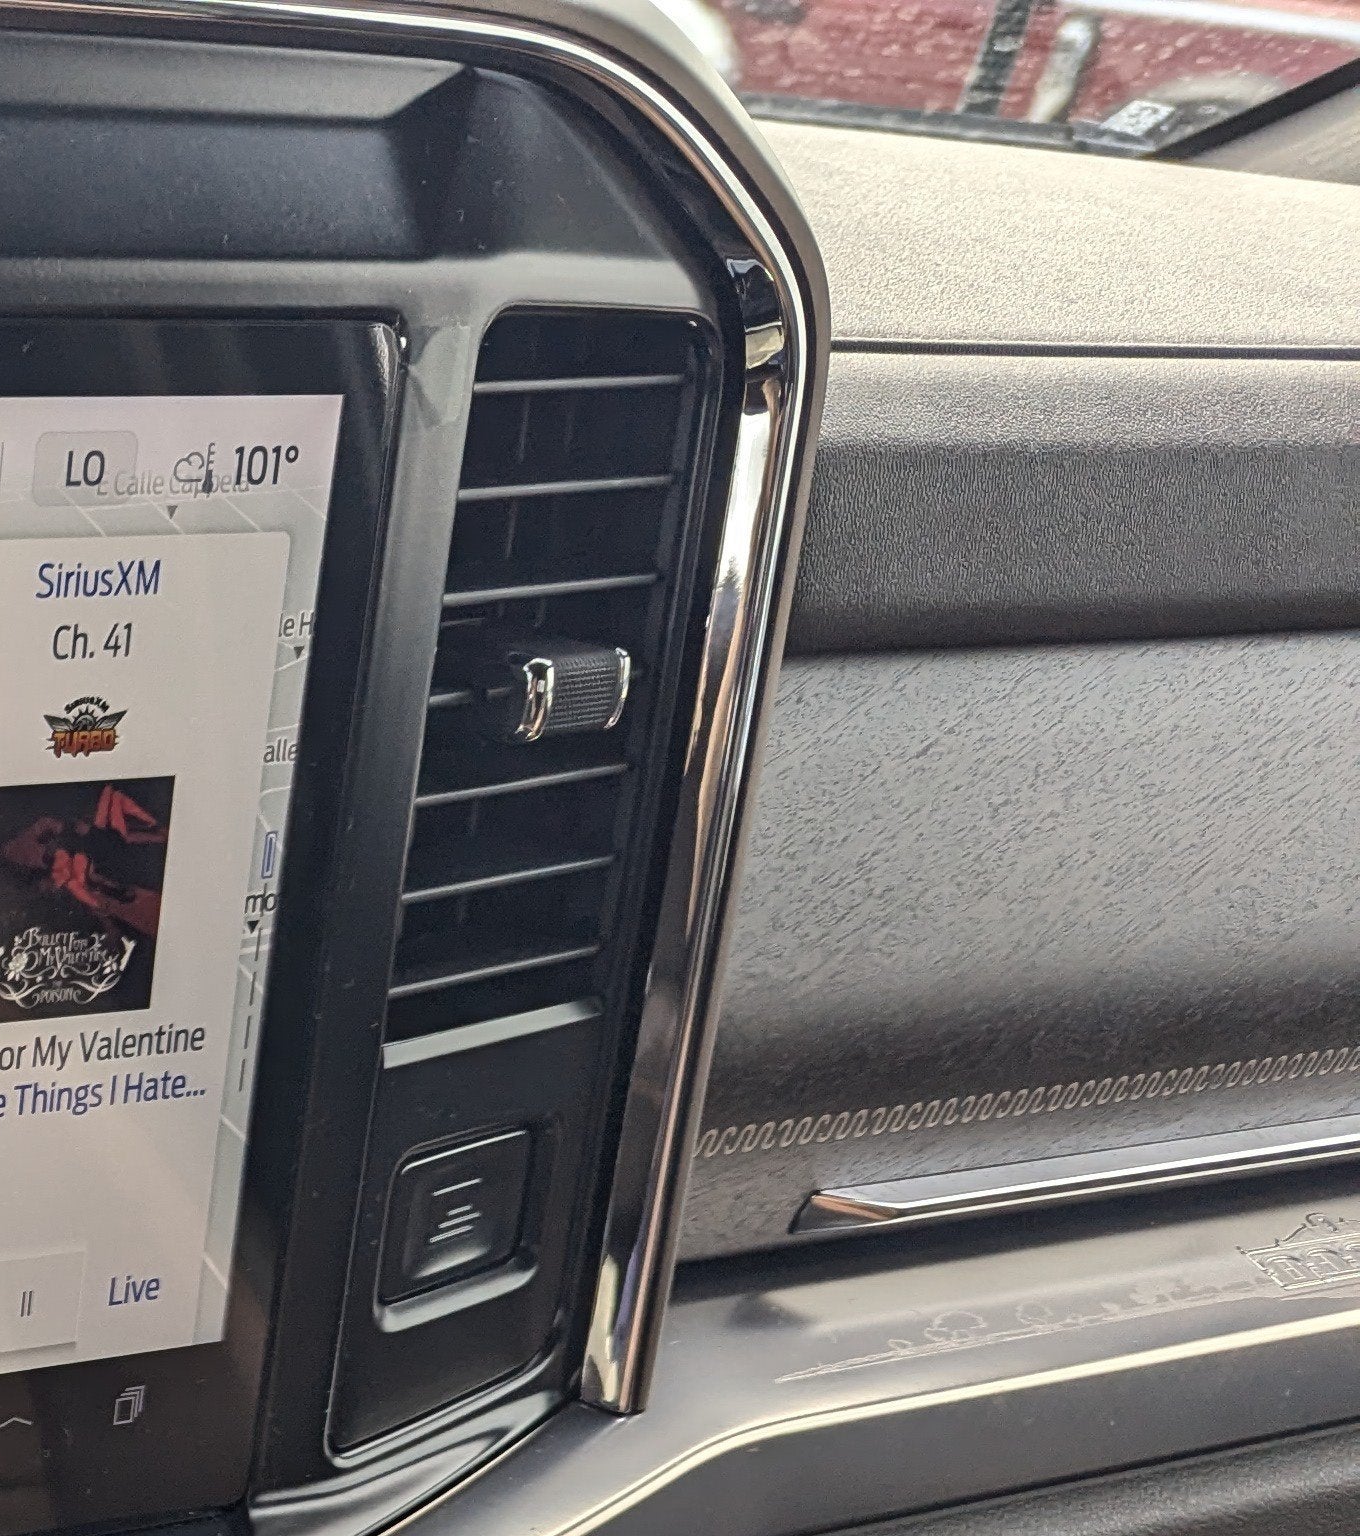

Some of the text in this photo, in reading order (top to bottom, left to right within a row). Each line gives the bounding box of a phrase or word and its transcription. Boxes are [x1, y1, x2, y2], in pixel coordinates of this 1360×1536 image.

[65, 450, 105, 487] LO
[36, 558, 162, 600] SiriusXM
[53, 624, 133, 661] Ch. 41
[32, 1035, 72, 1070] My
[79, 1023, 205, 1062] Valentine
[14, 1081, 103, 1116] Things
[109, 1077, 116, 1105] I
[123, 1072, 206, 1102] Hate...
[107, 1275, 160, 1307] Live
